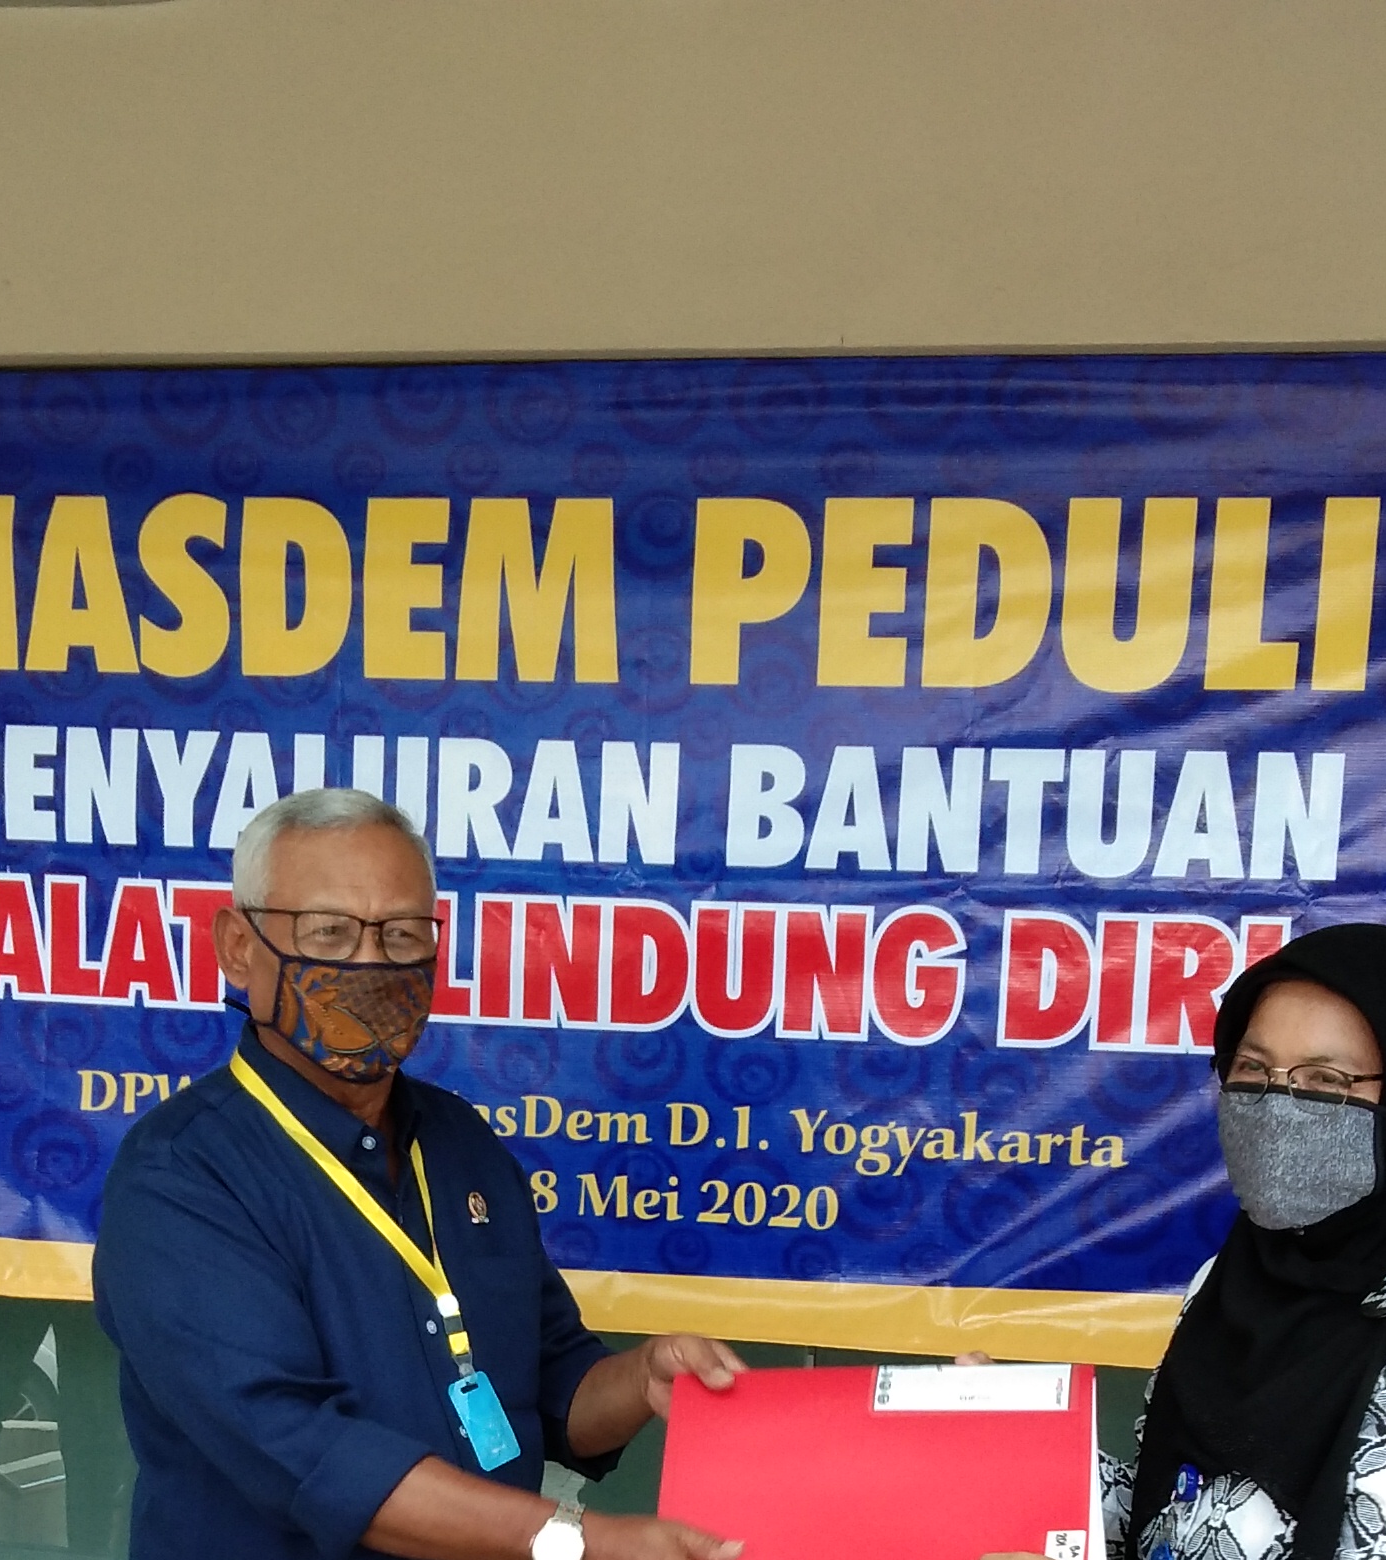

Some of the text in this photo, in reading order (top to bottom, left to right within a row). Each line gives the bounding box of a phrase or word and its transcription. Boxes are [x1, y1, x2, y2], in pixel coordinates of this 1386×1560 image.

[690, 497, 1381, 692] PEDULI
[725, 745, 1346, 882] BANTUAN
[427, 888, 966, 1047] LINDUNG
[576, 1173, 683, 1221] Mei
[696, 1180, 839, 1230] 2020
[789, 1108, 1129, 1177] Yogyakarta
